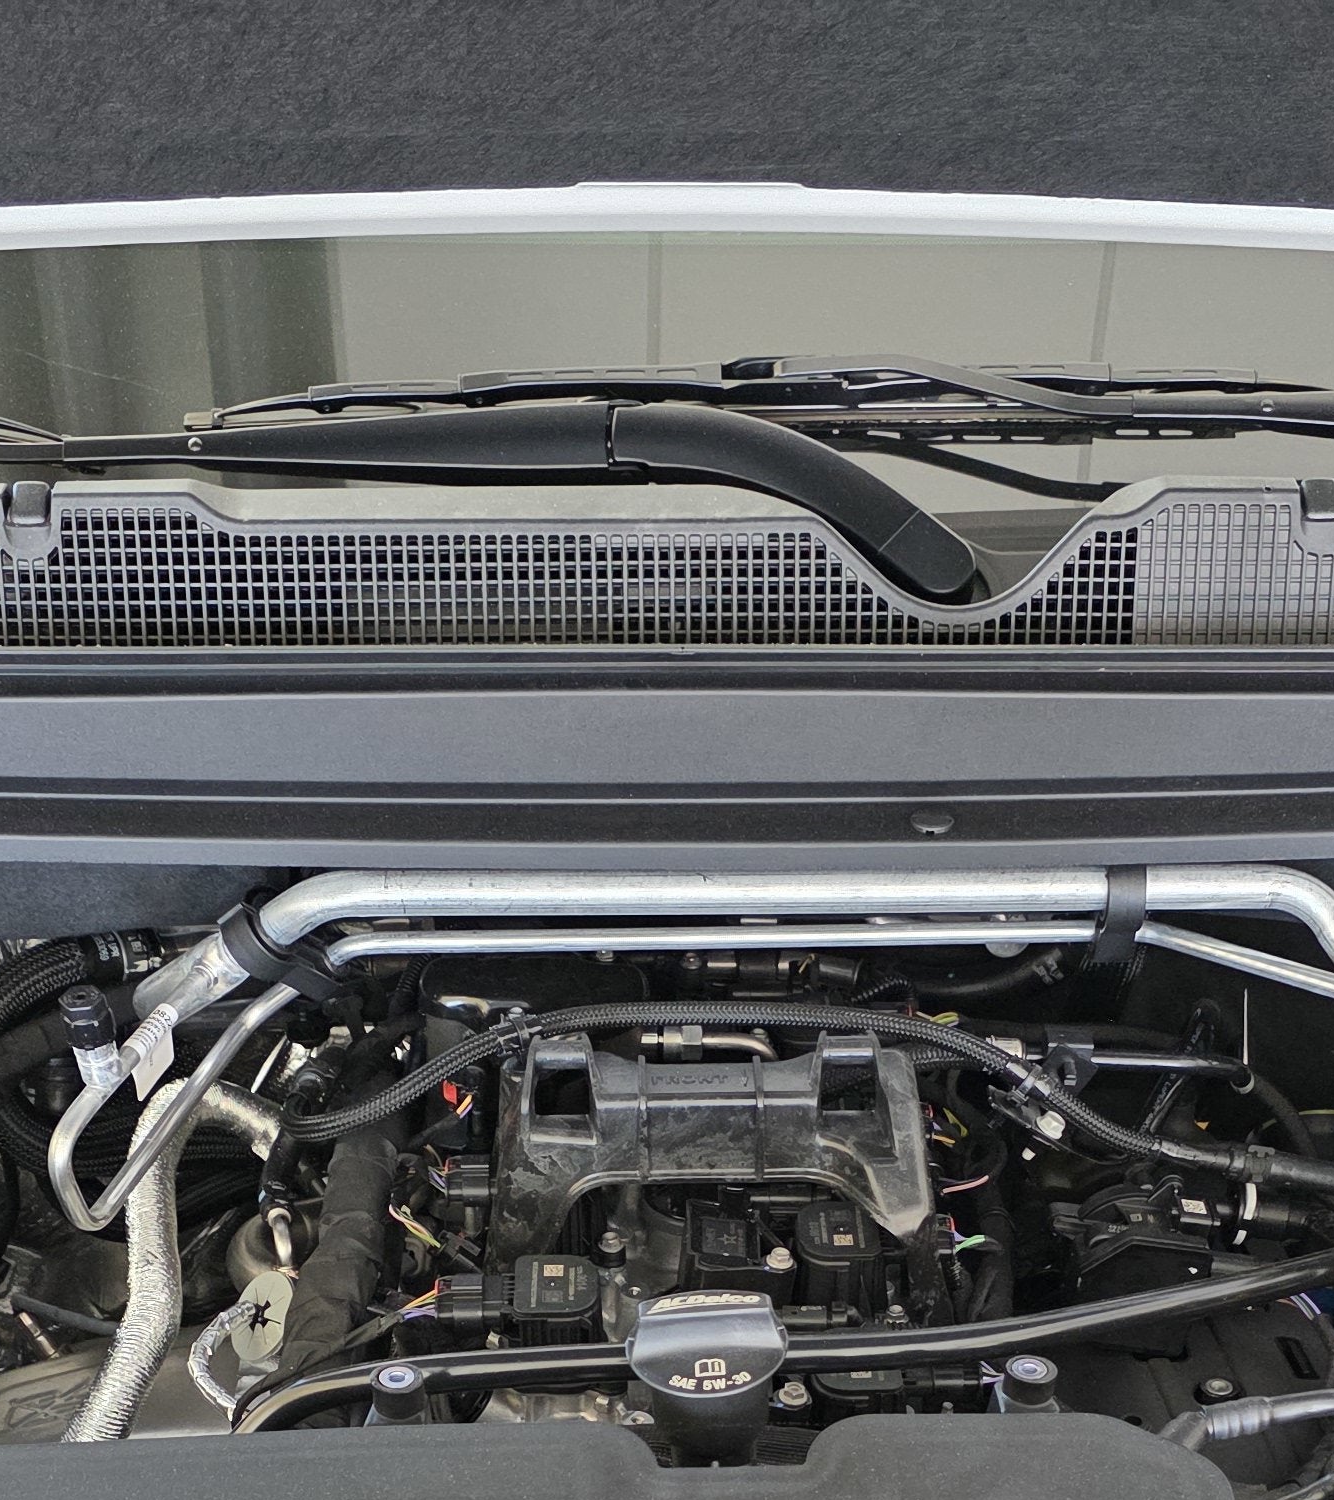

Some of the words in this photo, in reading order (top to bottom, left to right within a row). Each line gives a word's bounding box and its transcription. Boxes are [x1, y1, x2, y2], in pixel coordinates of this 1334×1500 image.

[654, 1293, 761, 1308] ACDelco
[668, 1375, 696, 1390] SAE
[702, 1371, 752, 1391] 5W-30
